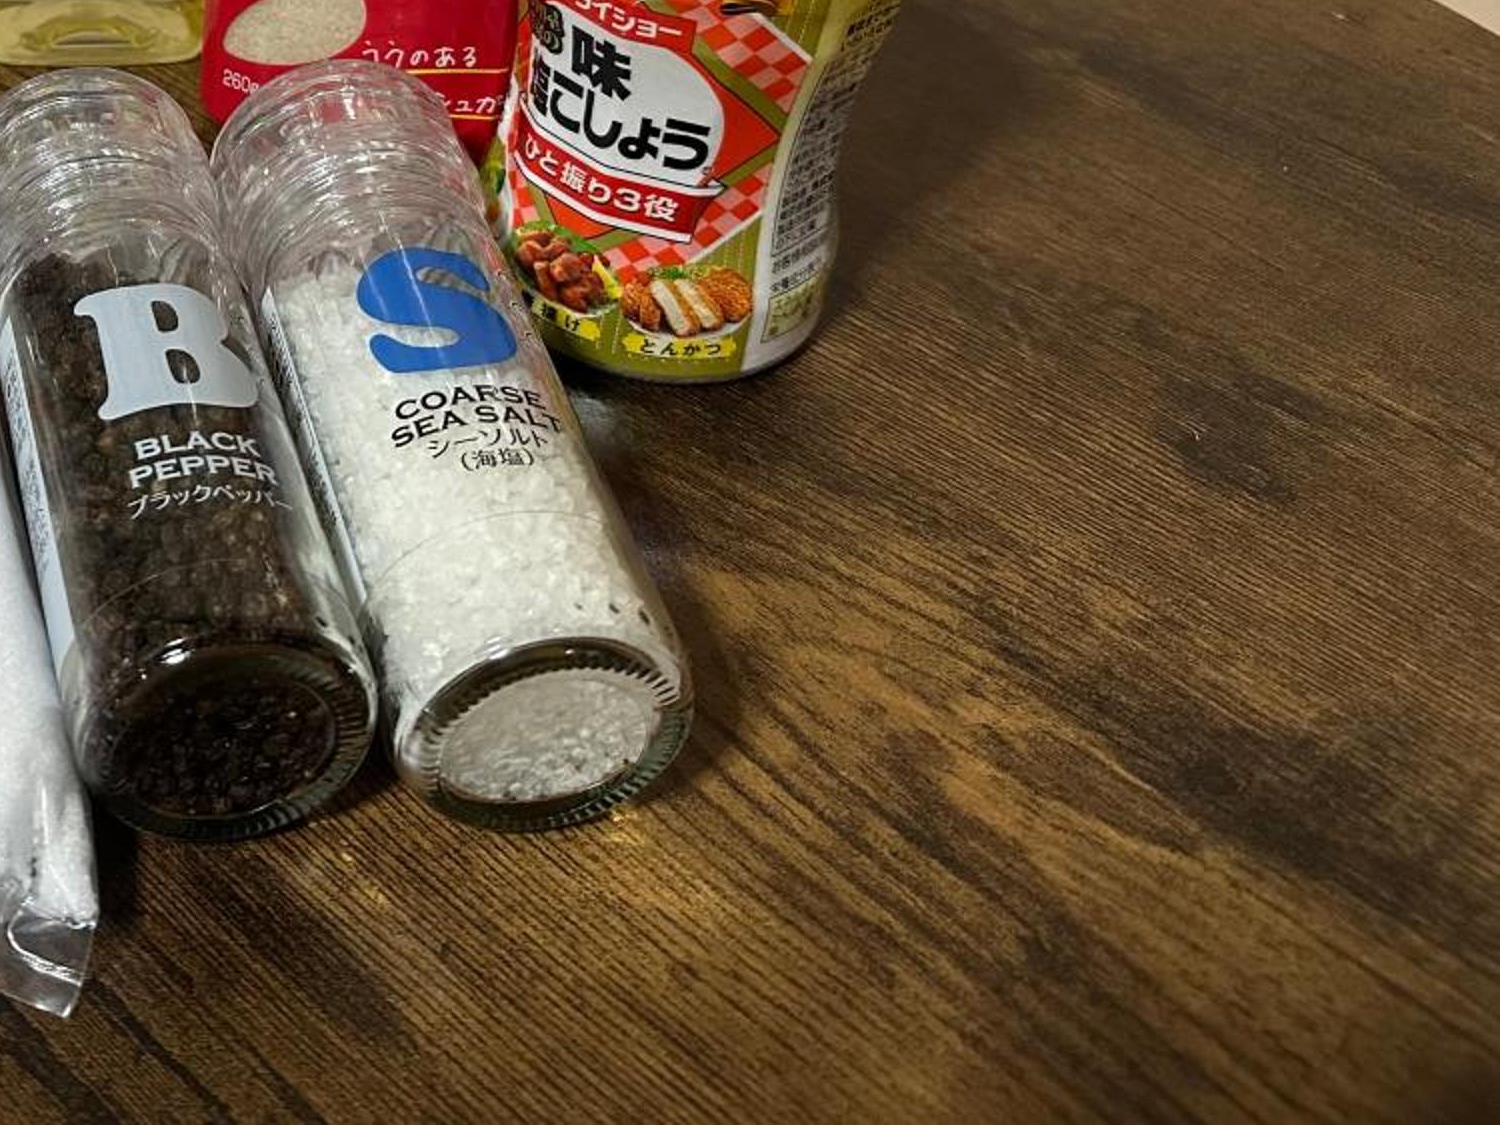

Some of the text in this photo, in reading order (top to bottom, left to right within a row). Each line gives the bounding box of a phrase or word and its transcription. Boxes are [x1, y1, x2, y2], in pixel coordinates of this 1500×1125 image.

[572, 24, 632, 101] 味
[523, 132, 681, 224] ひと振り3役
[356, 246, 517, 374] S
[73, 282, 261, 420] B
[395, 384, 546, 421] COARSE
[133, 431, 261, 460] BLACK
[391, 405, 562, 448] SEA SALT
[427, 426, 548, 459] シーソルト
[128, 454, 279, 489] PEPPER
